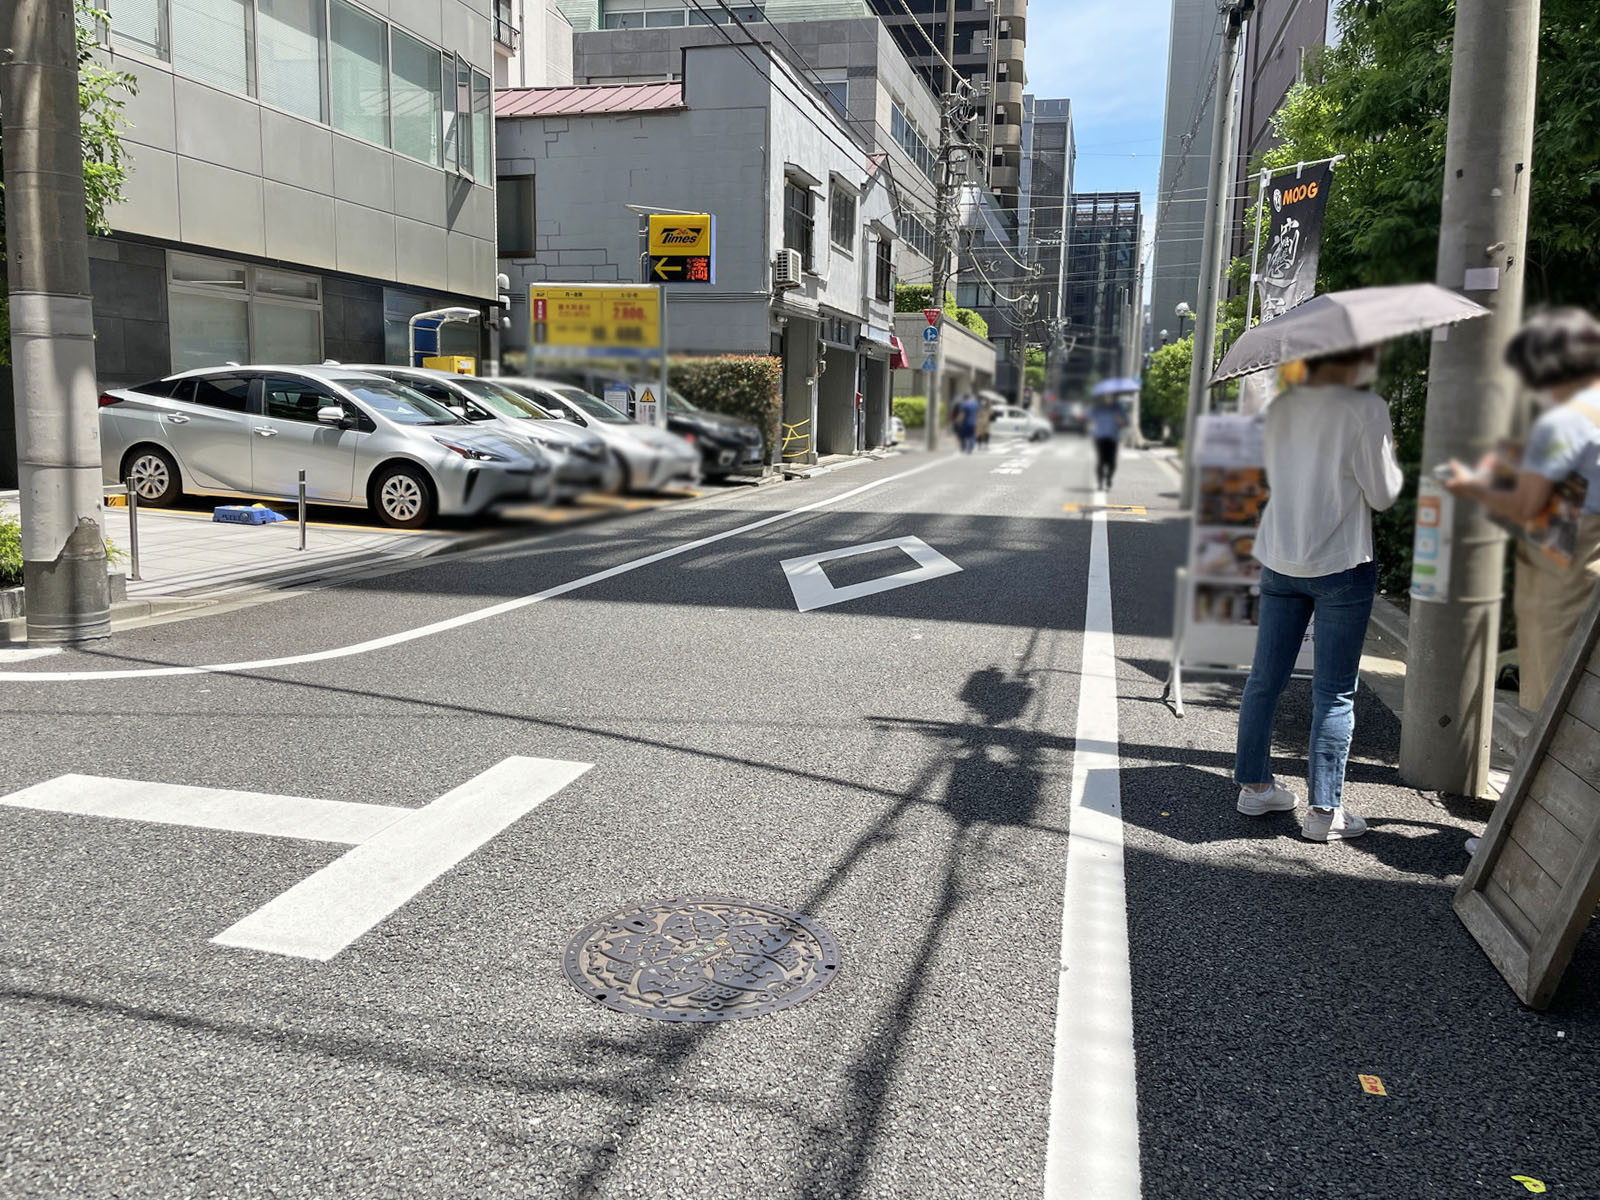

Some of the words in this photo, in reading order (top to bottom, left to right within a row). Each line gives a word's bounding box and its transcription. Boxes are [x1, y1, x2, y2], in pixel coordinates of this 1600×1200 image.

[1283, 182, 1318, 205] MOOG
[660, 228, 698, 244] Times
[686, 257, 708, 280] 満
